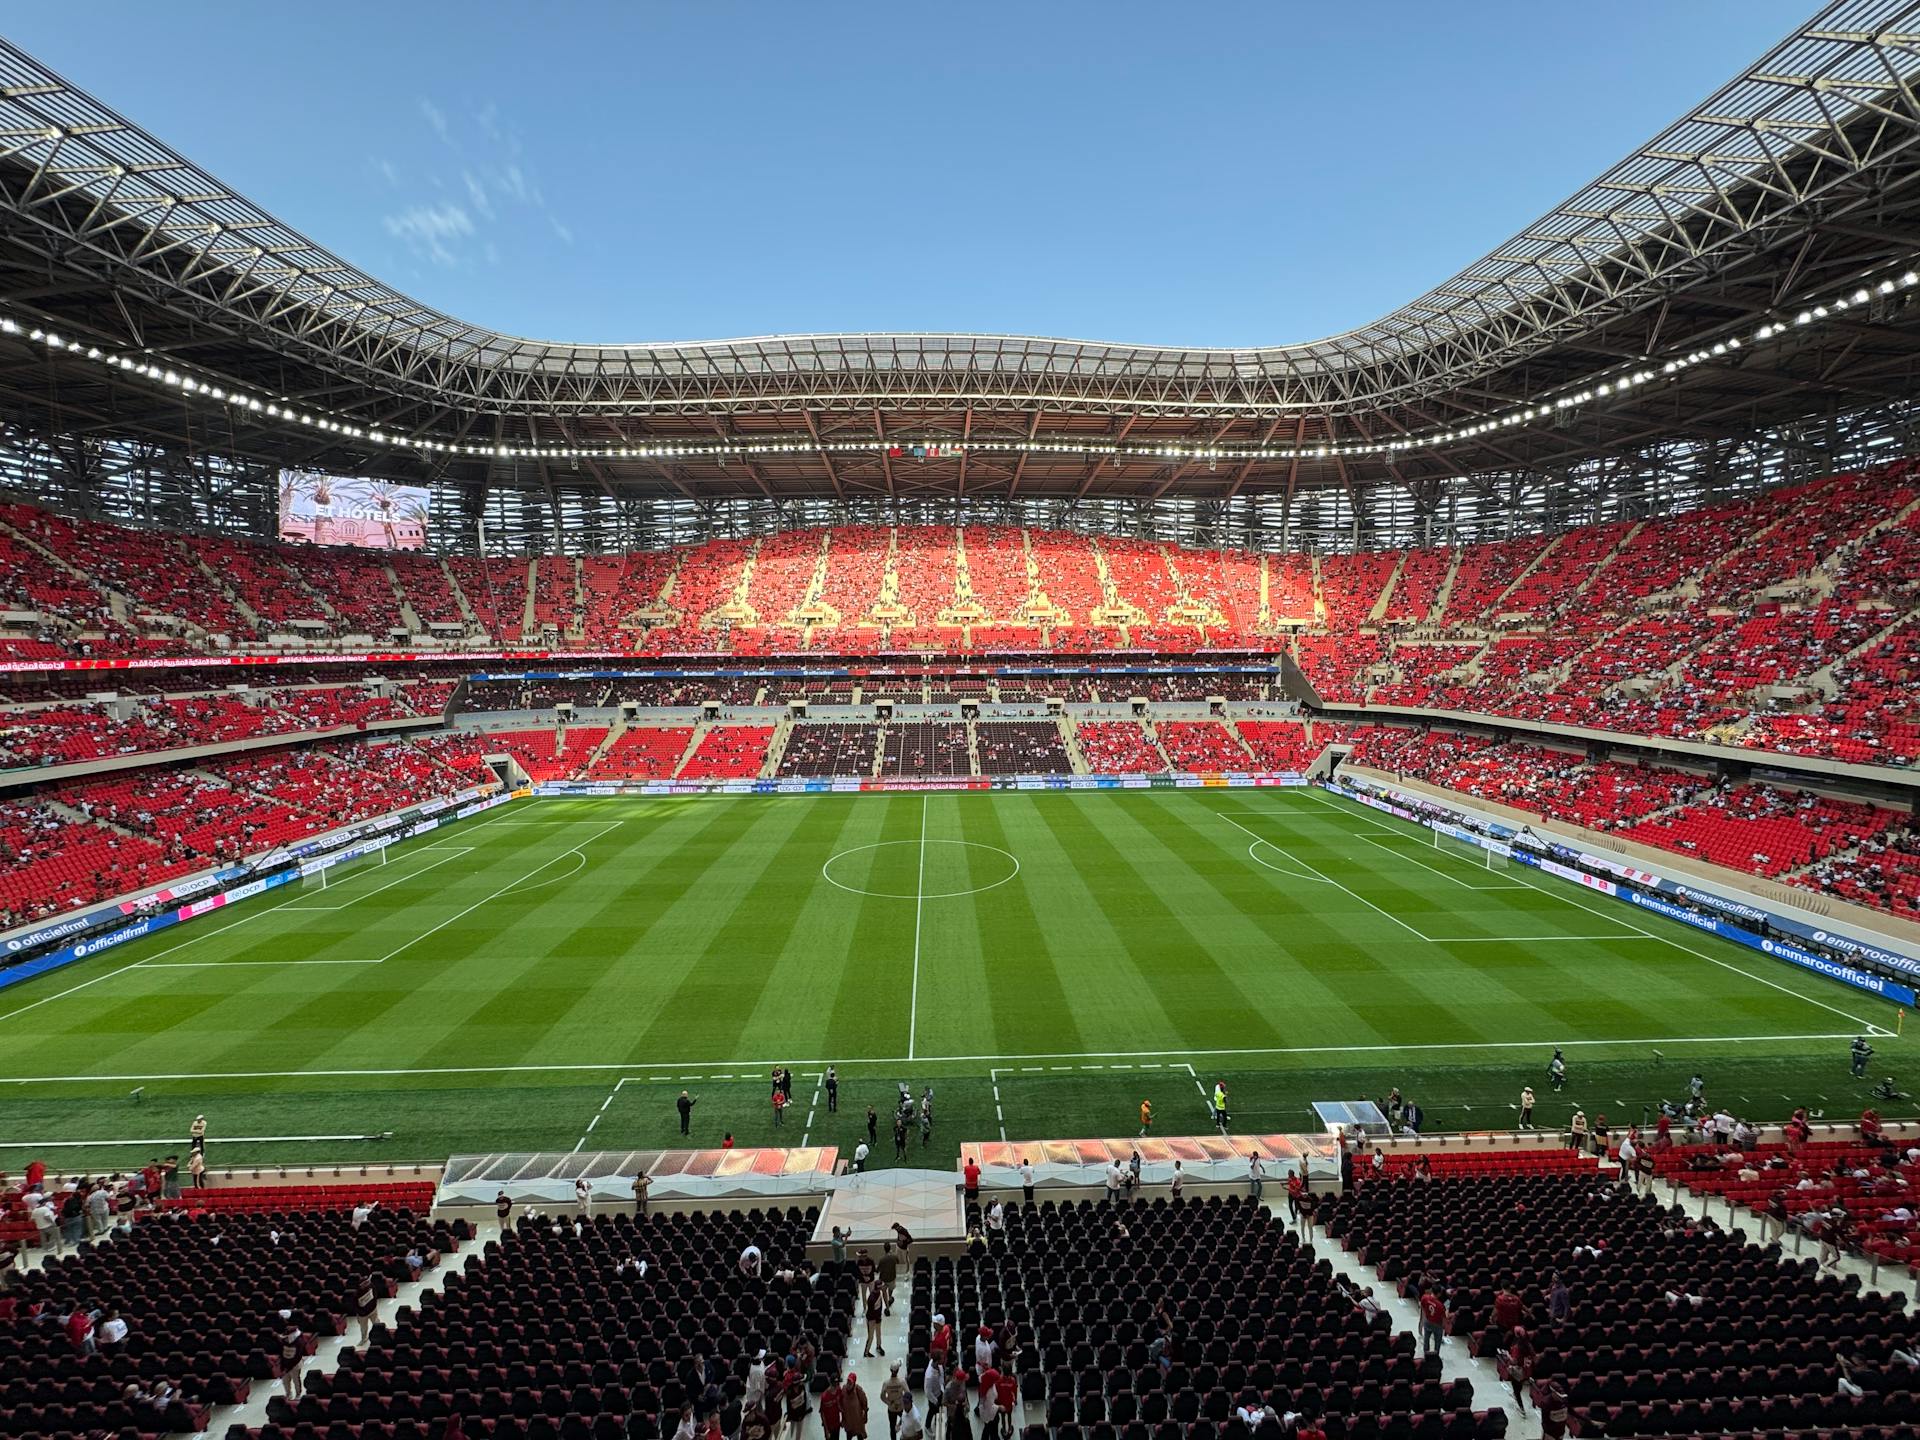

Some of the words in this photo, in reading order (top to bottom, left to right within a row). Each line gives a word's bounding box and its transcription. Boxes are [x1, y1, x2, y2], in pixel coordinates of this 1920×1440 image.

[316, 504, 334, 517] ET
[338, 505, 401, 525] HÔTELS
[189, 879, 210, 892] OCP
[242, 884, 261, 896] OCP
[1641, 898, 1718, 931] enmarocofficiel
[1685, 890, 1769, 921] enmarocofficiel
[22, 918, 90, 947] officielfrmf
[87, 923, 149, 953] officielfrmf
[1774, 947, 1884, 992] enmarocofficiel
